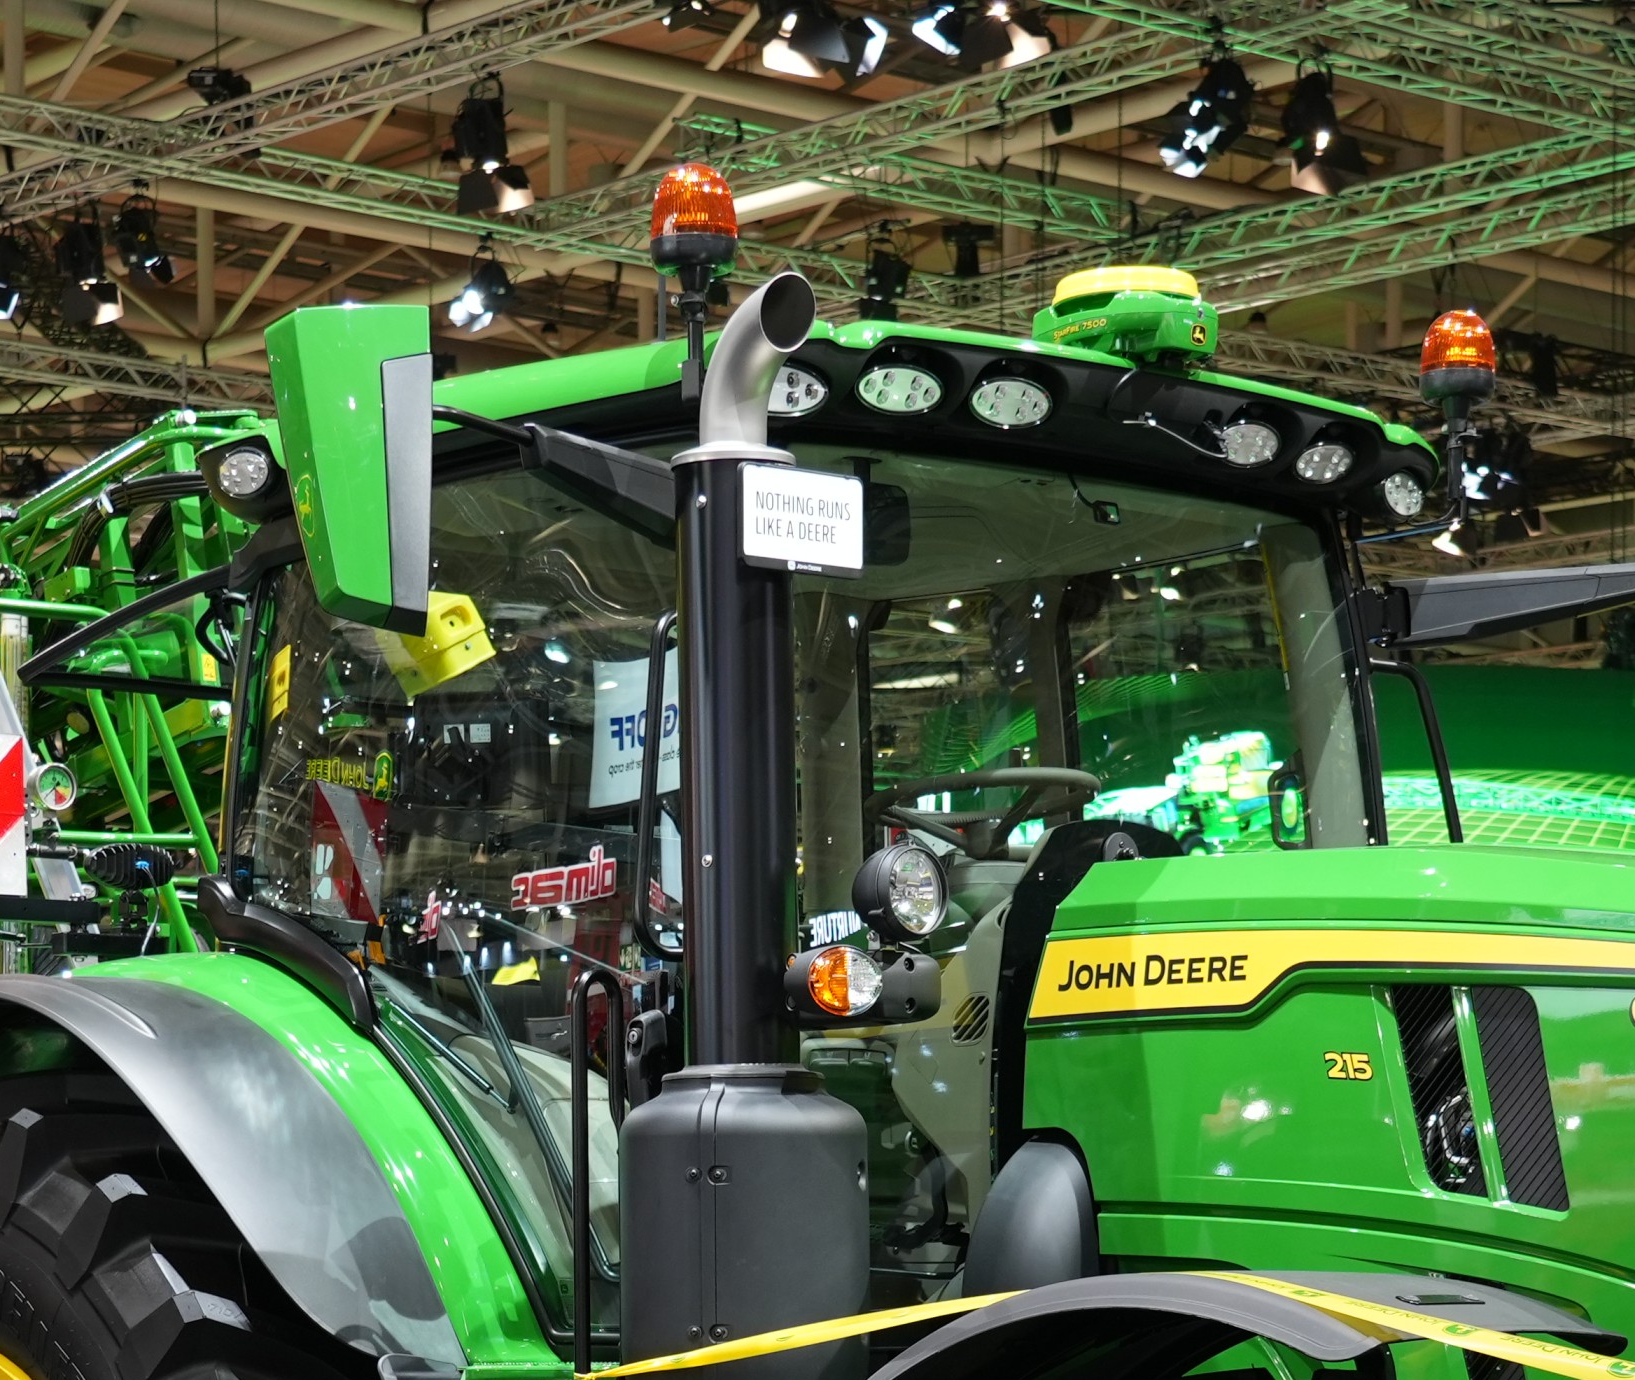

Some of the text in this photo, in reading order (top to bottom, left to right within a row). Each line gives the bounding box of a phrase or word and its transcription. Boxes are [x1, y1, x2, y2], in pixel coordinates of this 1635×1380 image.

[1082, 319, 1107, 330] 7500
[756, 490, 851, 521] NOTHING RUNS
[756, 516, 836, 544] LIKE A DEERE
[1057, 954, 1249, 993] JOHN DEERE
[1323, 1050, 1374, 1082] 215
